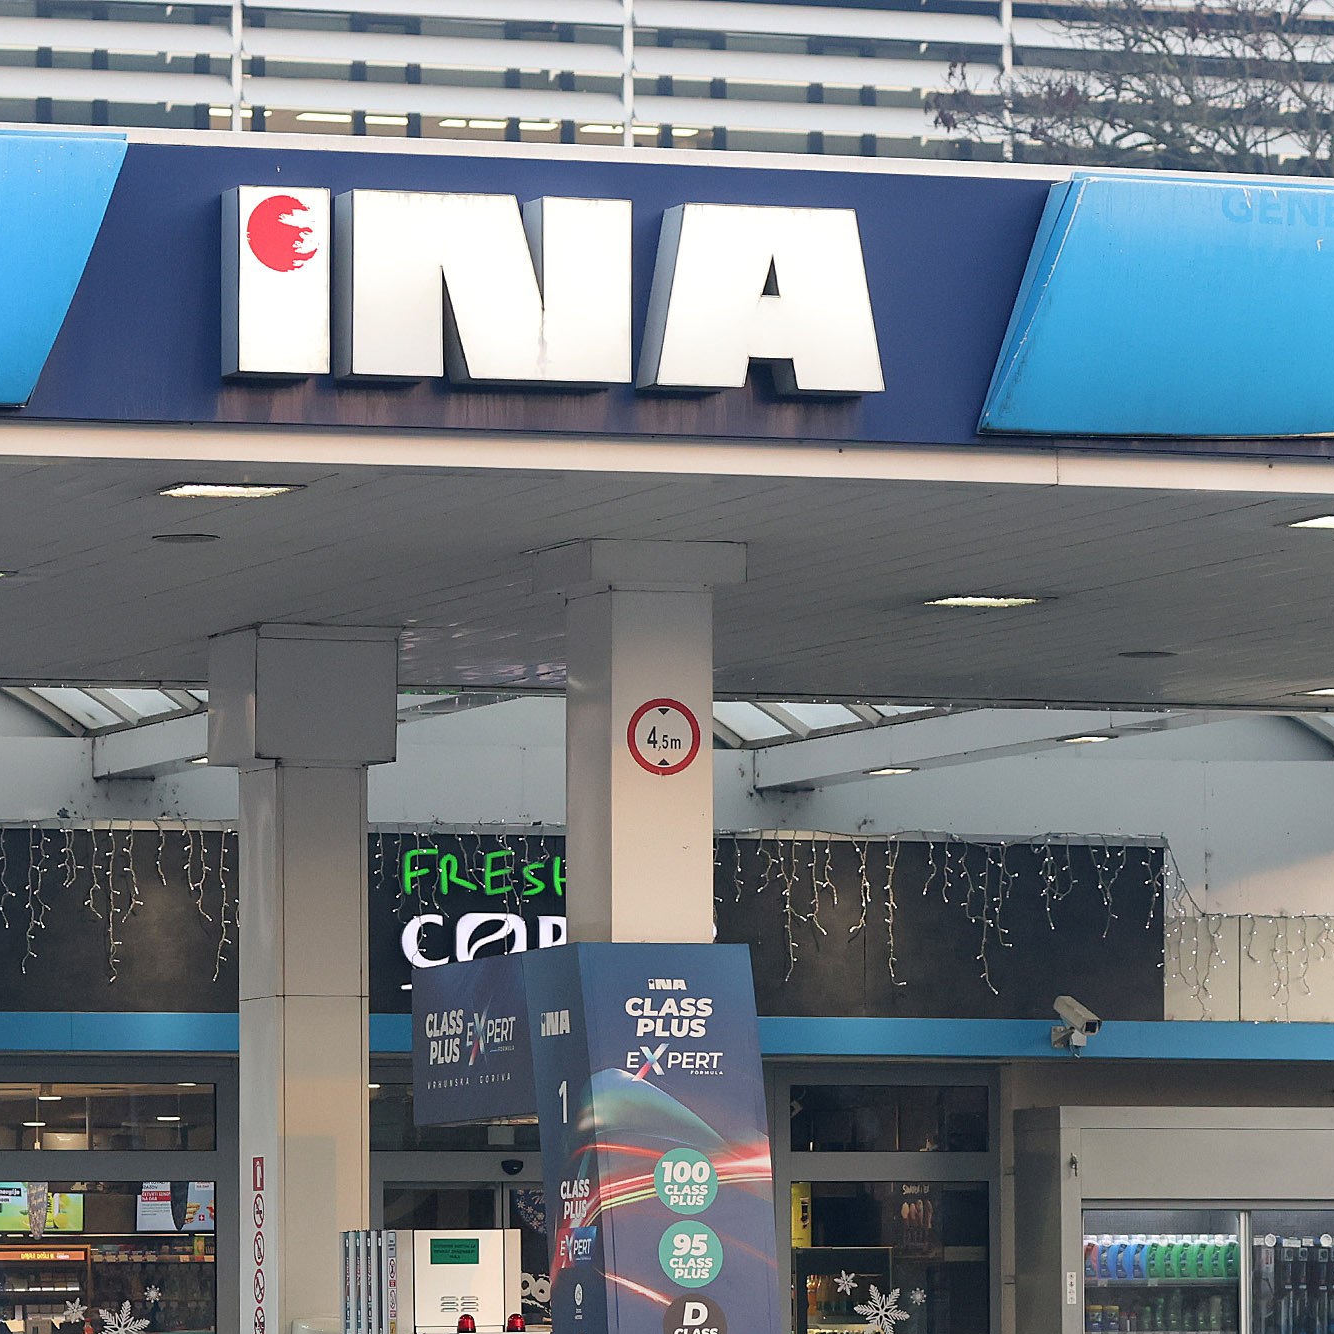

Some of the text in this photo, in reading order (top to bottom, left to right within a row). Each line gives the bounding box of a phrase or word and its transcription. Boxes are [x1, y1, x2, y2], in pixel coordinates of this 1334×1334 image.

[223, 185, 885, 393] INA
[648, 978, 687, 990] INA
[624, 997, 713, 1017] CLASS
[425, 1009, 464, 1038] CLASS
[540, 1009, 570, 1037] INA
[636, 1018, 706, 1038] PLUS
[466, 1012, 516, 1066] EXPERT
[429, 1037, 460, 1065] PLUS
[626, 1043, 724, 1081] EXPERT
[479, 1072, 511, 1084] GORIVA
[558, 1081, 568, 1123] 1
[662, 1161, 710, 1183] 100
[560, 1179, 590, 1200] CLASS
[664, 1185, 708, 1195] CLASS
[563, 1199, 587, 1220] PLUS
[669, 1196, 705, 1206] PLUS
[560, 1234, 592, 1268] EXPERT
[672, 1233, 708, 1256] 95
[669, 1258, 713, 1268] CLASS
[674, 1269, 710, 1279] PLUS
[682, 1302, 708, 1326] D
